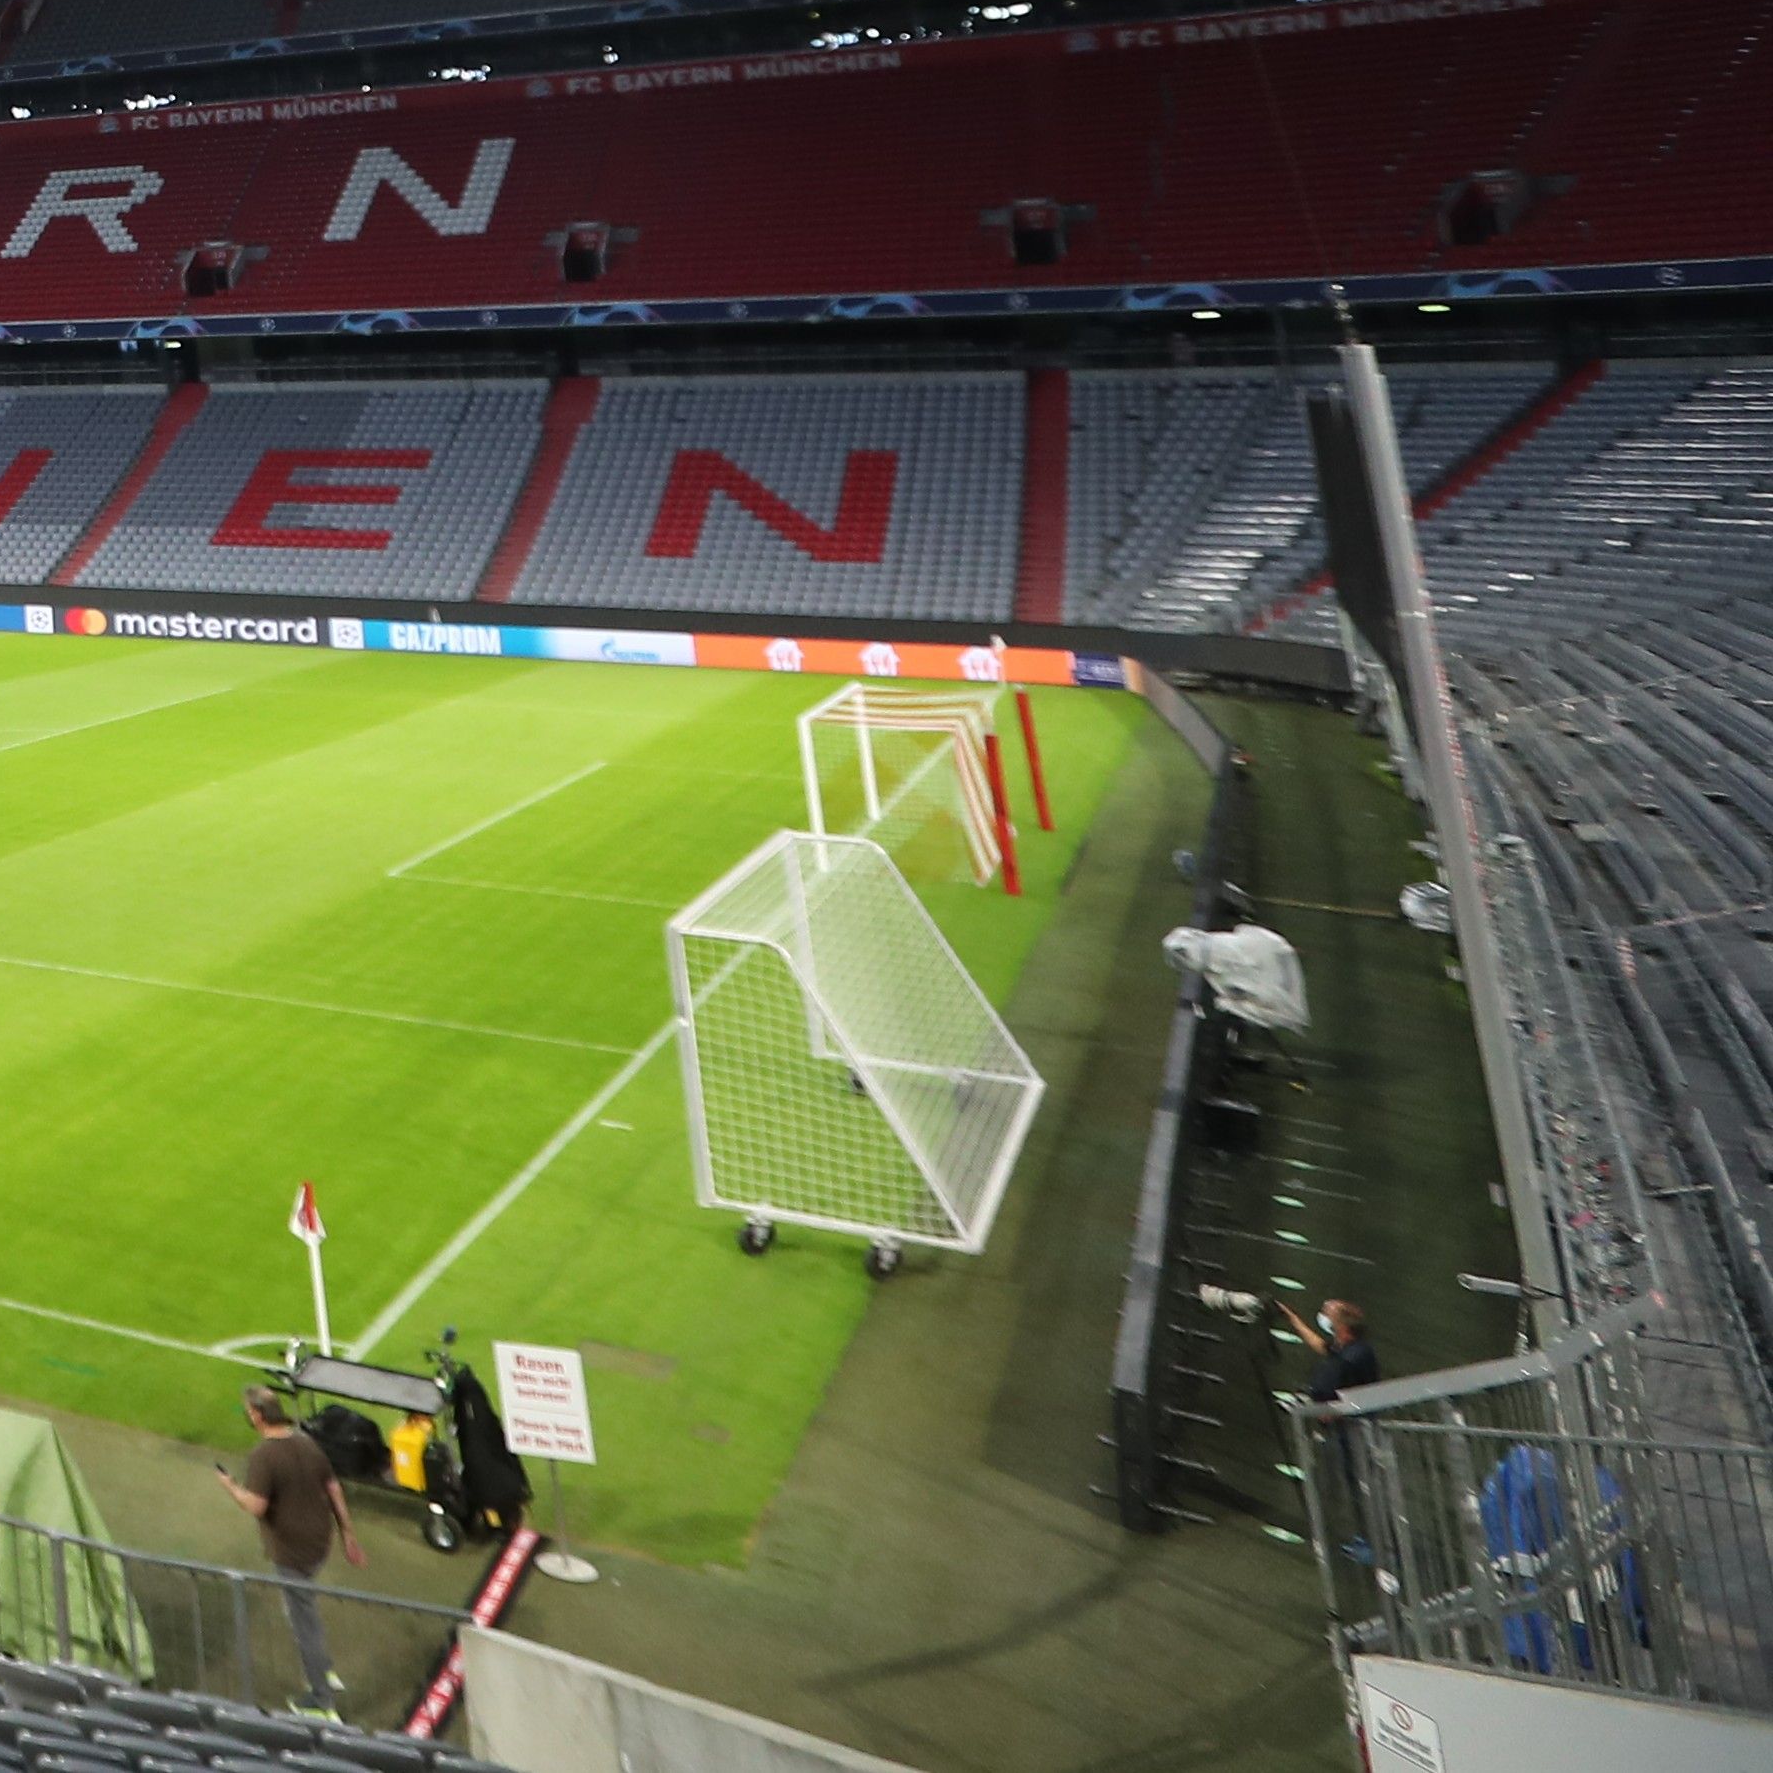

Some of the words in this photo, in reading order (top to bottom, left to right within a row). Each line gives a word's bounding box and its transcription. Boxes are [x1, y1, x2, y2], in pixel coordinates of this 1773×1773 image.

[566, 76, 602, 95] FC
[613, 66, 732, 93] BAYERN
[131, 115, 159, 131] FC
[169, 105, 263, 129] BAYERN
[272, 93, 398, 119] MÜNCHEN
[114, 610, 318, 644] mastercard
[390, 621, 502, 655] GAZPROM
